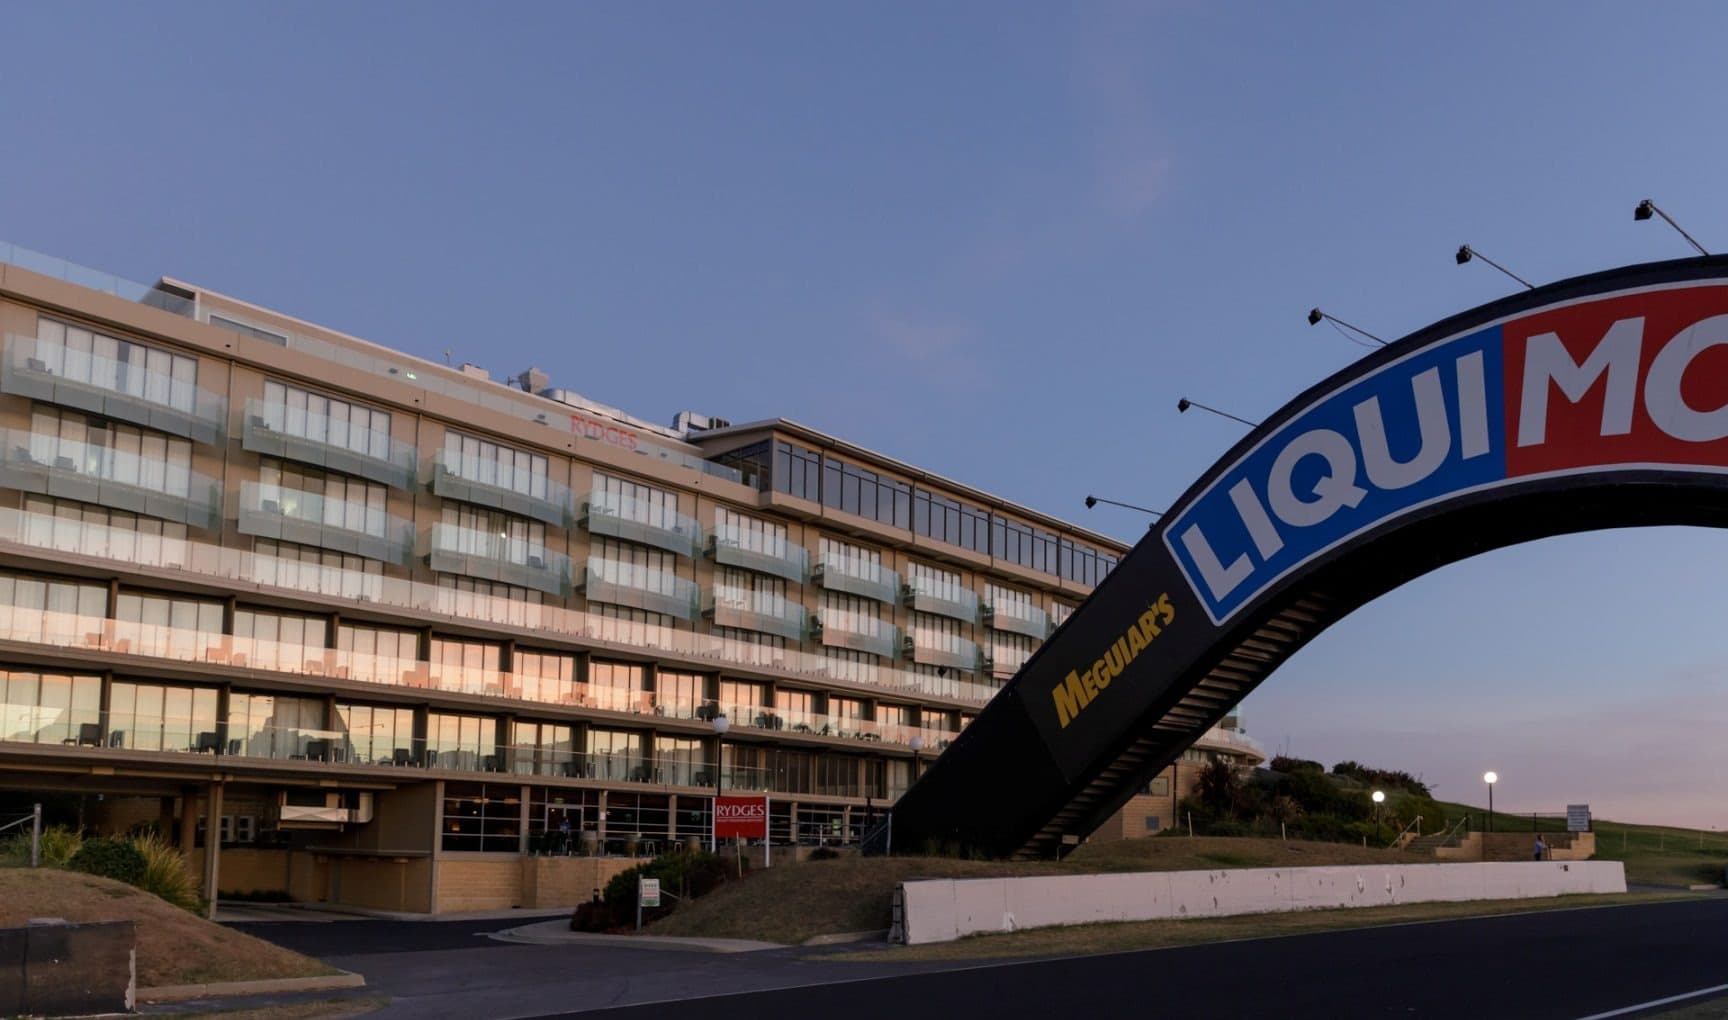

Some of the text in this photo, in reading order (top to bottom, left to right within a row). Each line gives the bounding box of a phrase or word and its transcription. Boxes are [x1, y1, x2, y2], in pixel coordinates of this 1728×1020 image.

[569, 415, 637, 450] RYDGES
[1181, 313, 1728, 602] LIQUI MO
[1052, 592, 1175, 729] MEGUIAR'S
[716, 804, 765, 816] RYDGES
